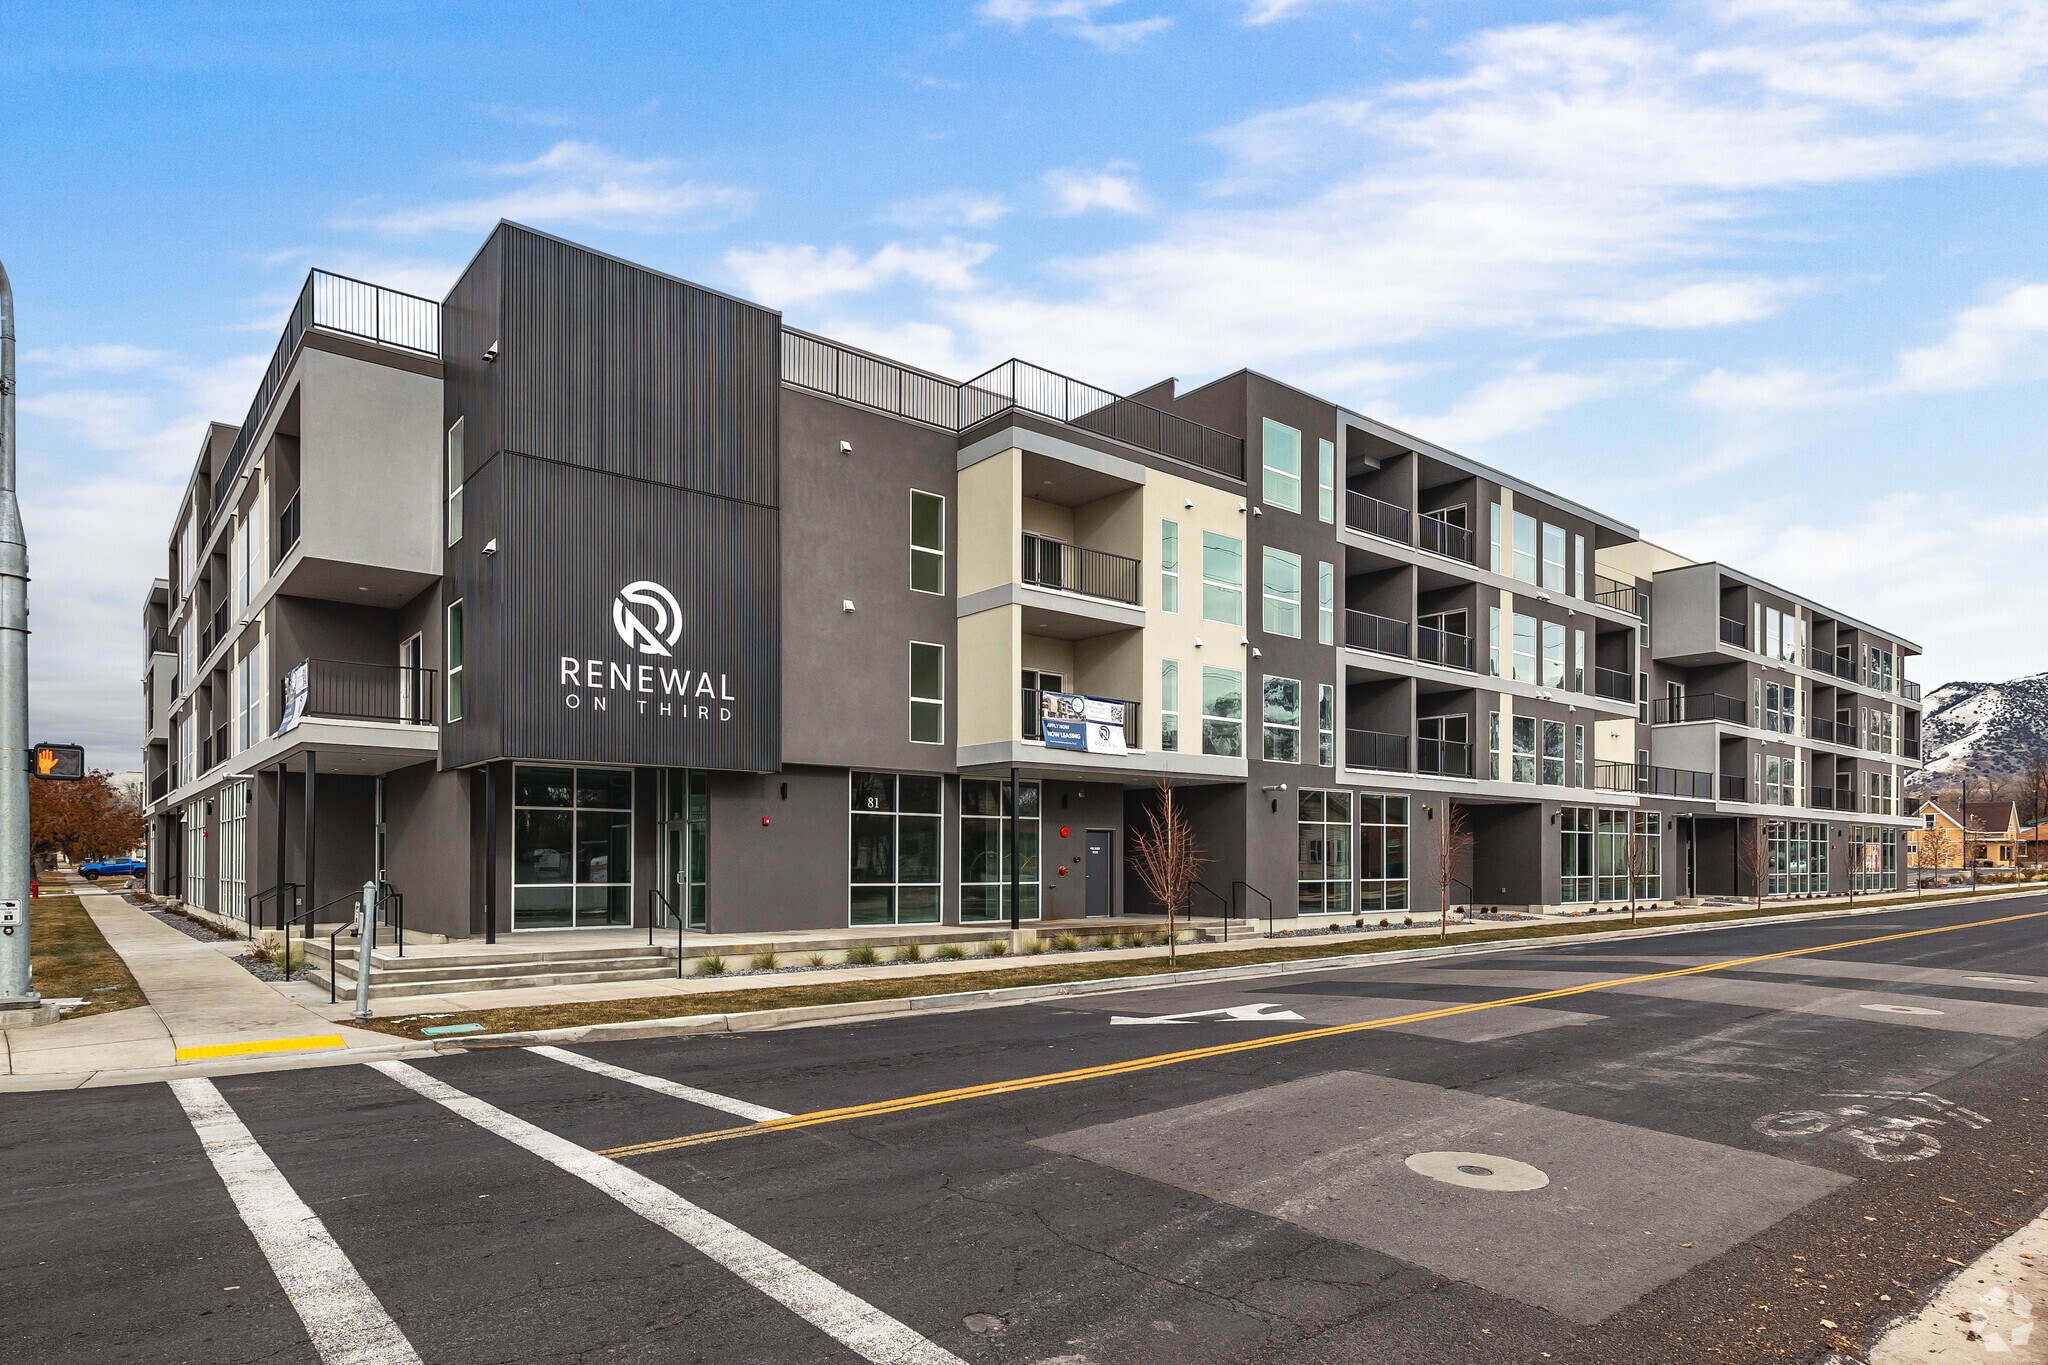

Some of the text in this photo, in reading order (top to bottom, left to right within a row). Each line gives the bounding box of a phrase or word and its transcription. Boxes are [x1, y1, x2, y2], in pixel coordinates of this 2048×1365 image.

[561, 656, 735, 701] RENEWAL
[565, 694, 731, 721] ON THIRD
[1060, 732, 1082, 740] LEASING
[868, 796, 880, 808] 81
